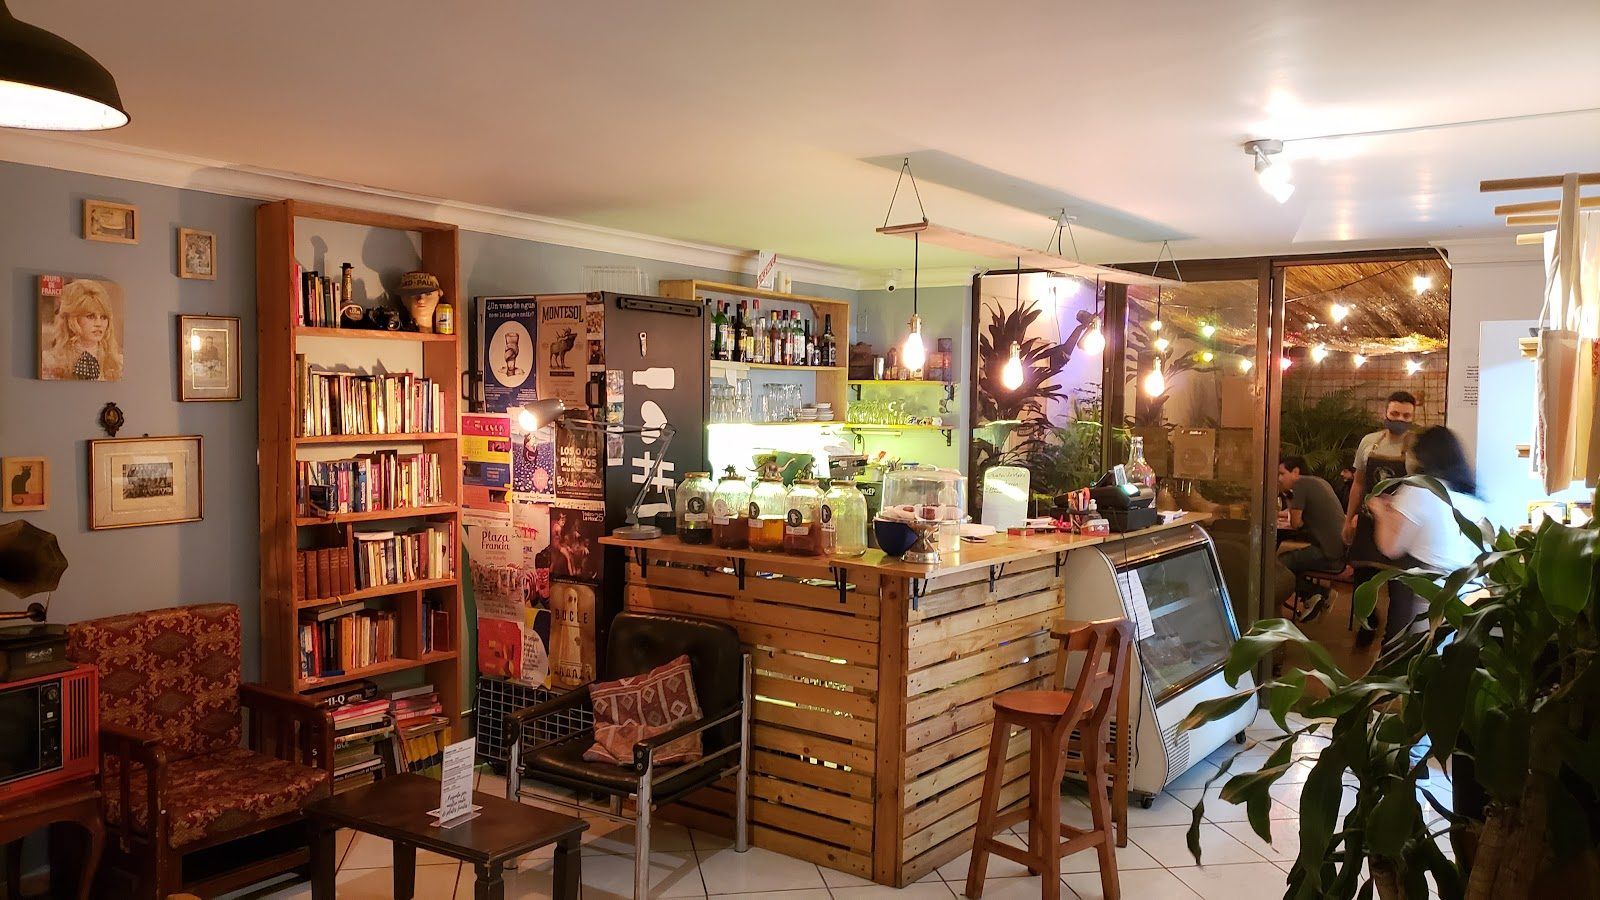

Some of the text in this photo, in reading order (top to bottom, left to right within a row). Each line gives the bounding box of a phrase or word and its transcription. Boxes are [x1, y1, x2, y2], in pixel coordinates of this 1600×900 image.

[41, 287, 62, 296] FRANCE
[541, 304, 584, 324] MONTESOL
[560, 446, 575, 456] LOS
[481, 529, 510, 543] Plaza
[481, 541, 510, 550] Francia
